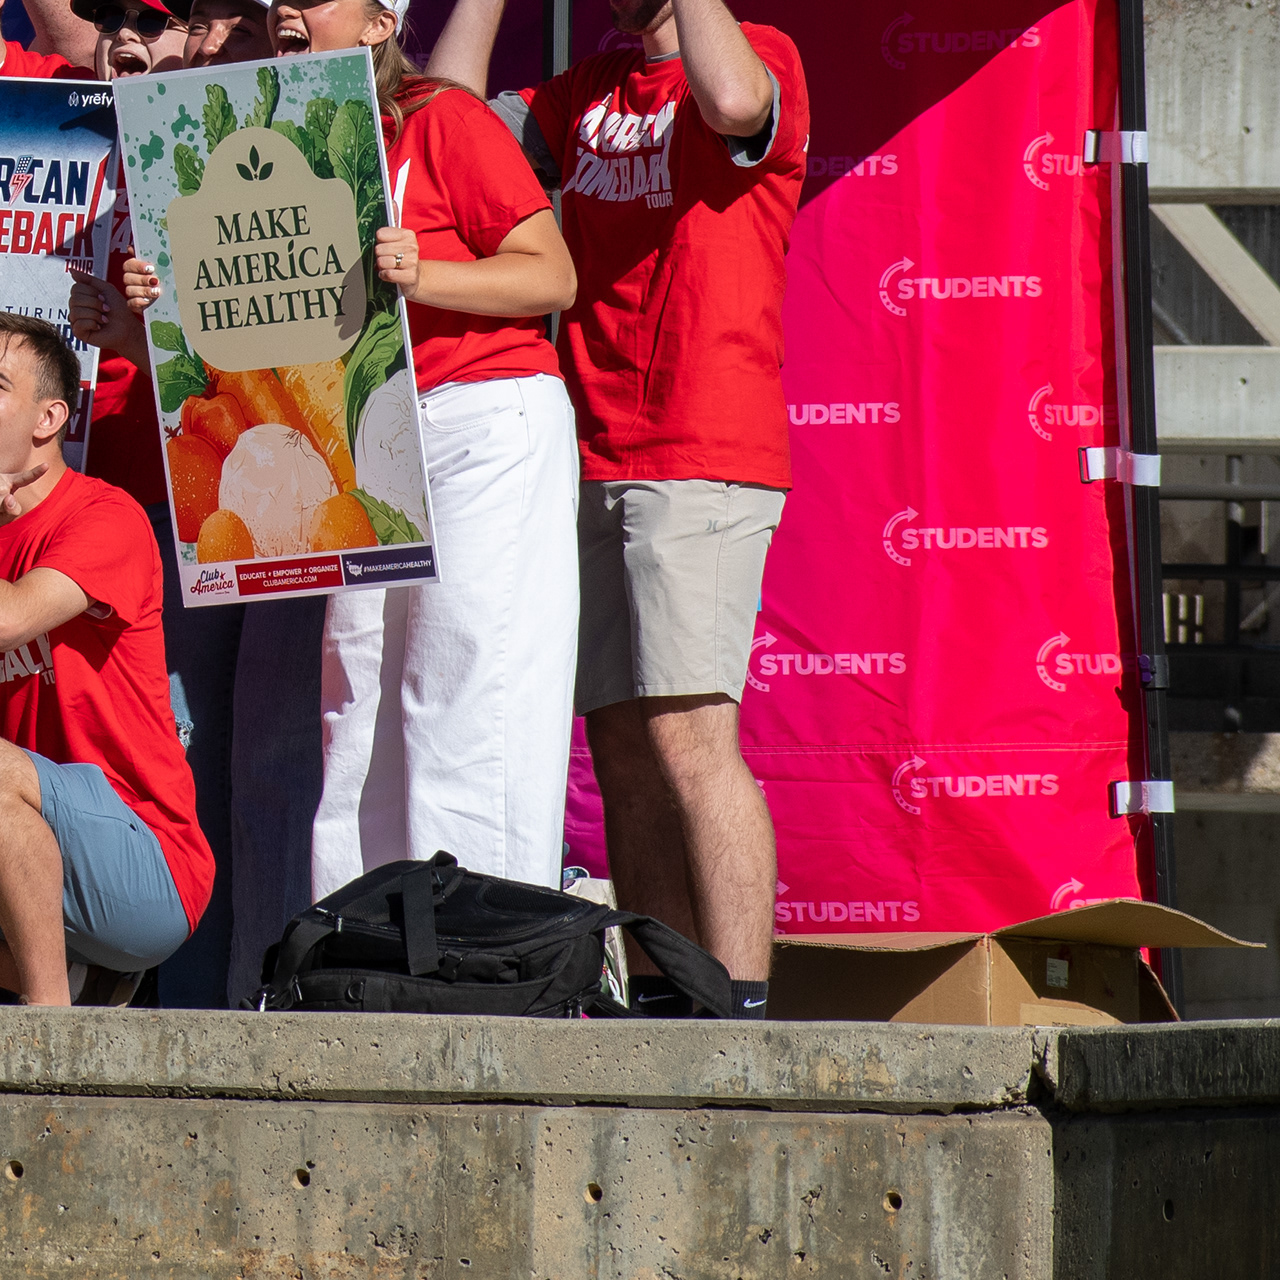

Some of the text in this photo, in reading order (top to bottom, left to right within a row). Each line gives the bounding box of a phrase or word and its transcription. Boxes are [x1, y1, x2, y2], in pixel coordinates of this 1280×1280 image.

[898, 27, 1040, 53] STUDENTS
[809, 156, 899, 177] DENTS
[644, 192, 674, 209] TOUR
[215, 205, 311, 246] MAKE
[194, 240, 345, 291] AMERICA
[898, 275, 1042, 300] STUDENTS
[198, 286, 347, 332] HEALTHY
[787, 402, 900, 425] UDENTS
[1044, 405, 1116, 427] STUDE
[901, 527, 1048, 549] STUDENTS
[200, 569, 219, 584] Club
[240, 565, 338, 580] EDUCATE EMPOWER ORGANIZE
[364, 560, 432, 573] #MAKEAMERICAHEALTHY
[190, 580, 234, 595] America
[263, 576, 317, 587] CLUBAMERICA.COM
[759, 653, 907, 676] STUDENTS
[910, 774, 1059, 798] STUDENTS
[775, 901, 920, 923] STUDENTS
